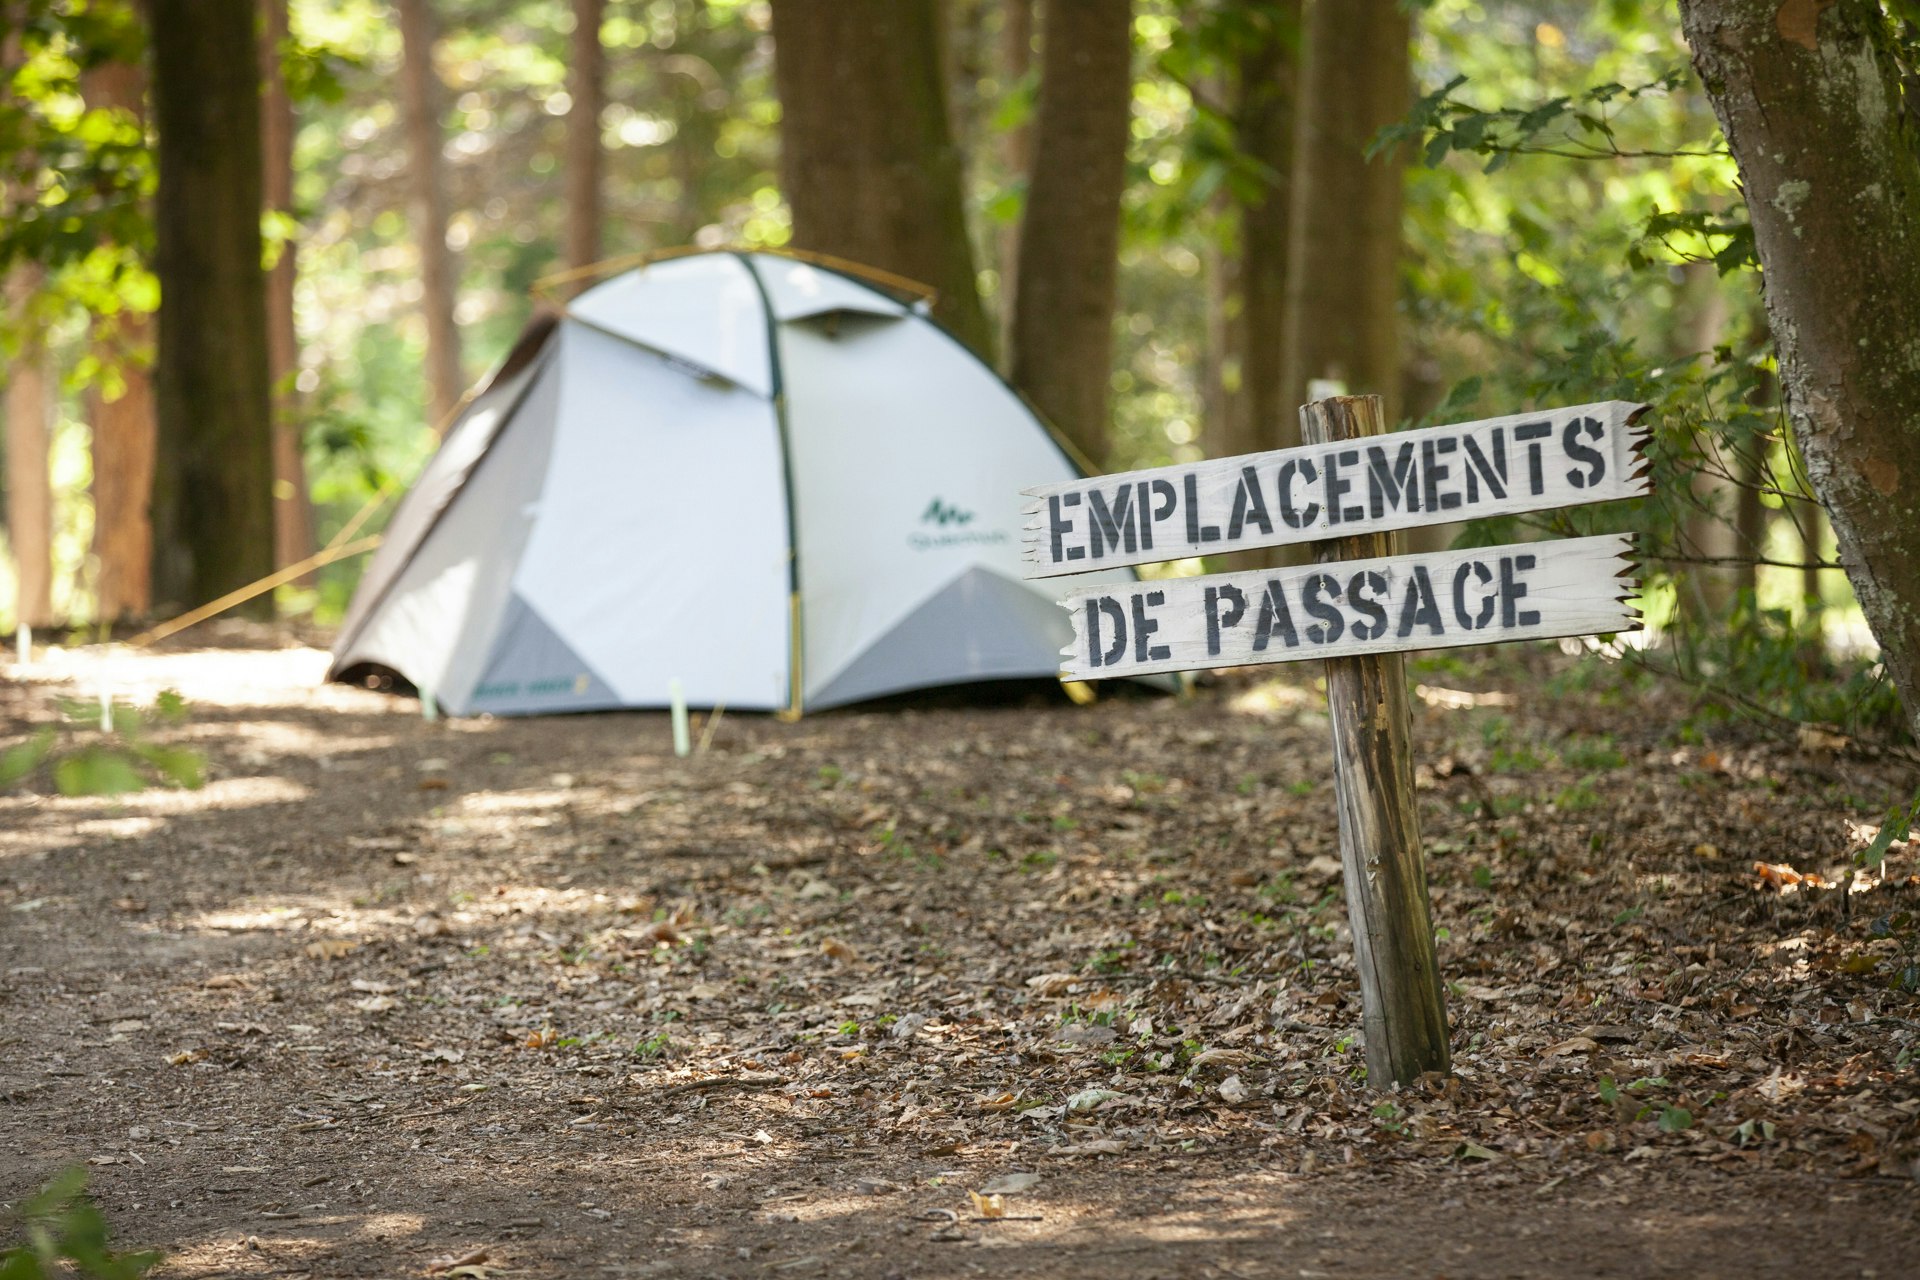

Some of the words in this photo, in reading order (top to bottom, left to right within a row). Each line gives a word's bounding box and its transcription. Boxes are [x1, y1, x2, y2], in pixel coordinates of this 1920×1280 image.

[1048, 416, 1606, 563] EMPLACEMENTS
[1086, 590, 1172, 668] DE
[1203, 554, 1541, 656] PASSAGE
